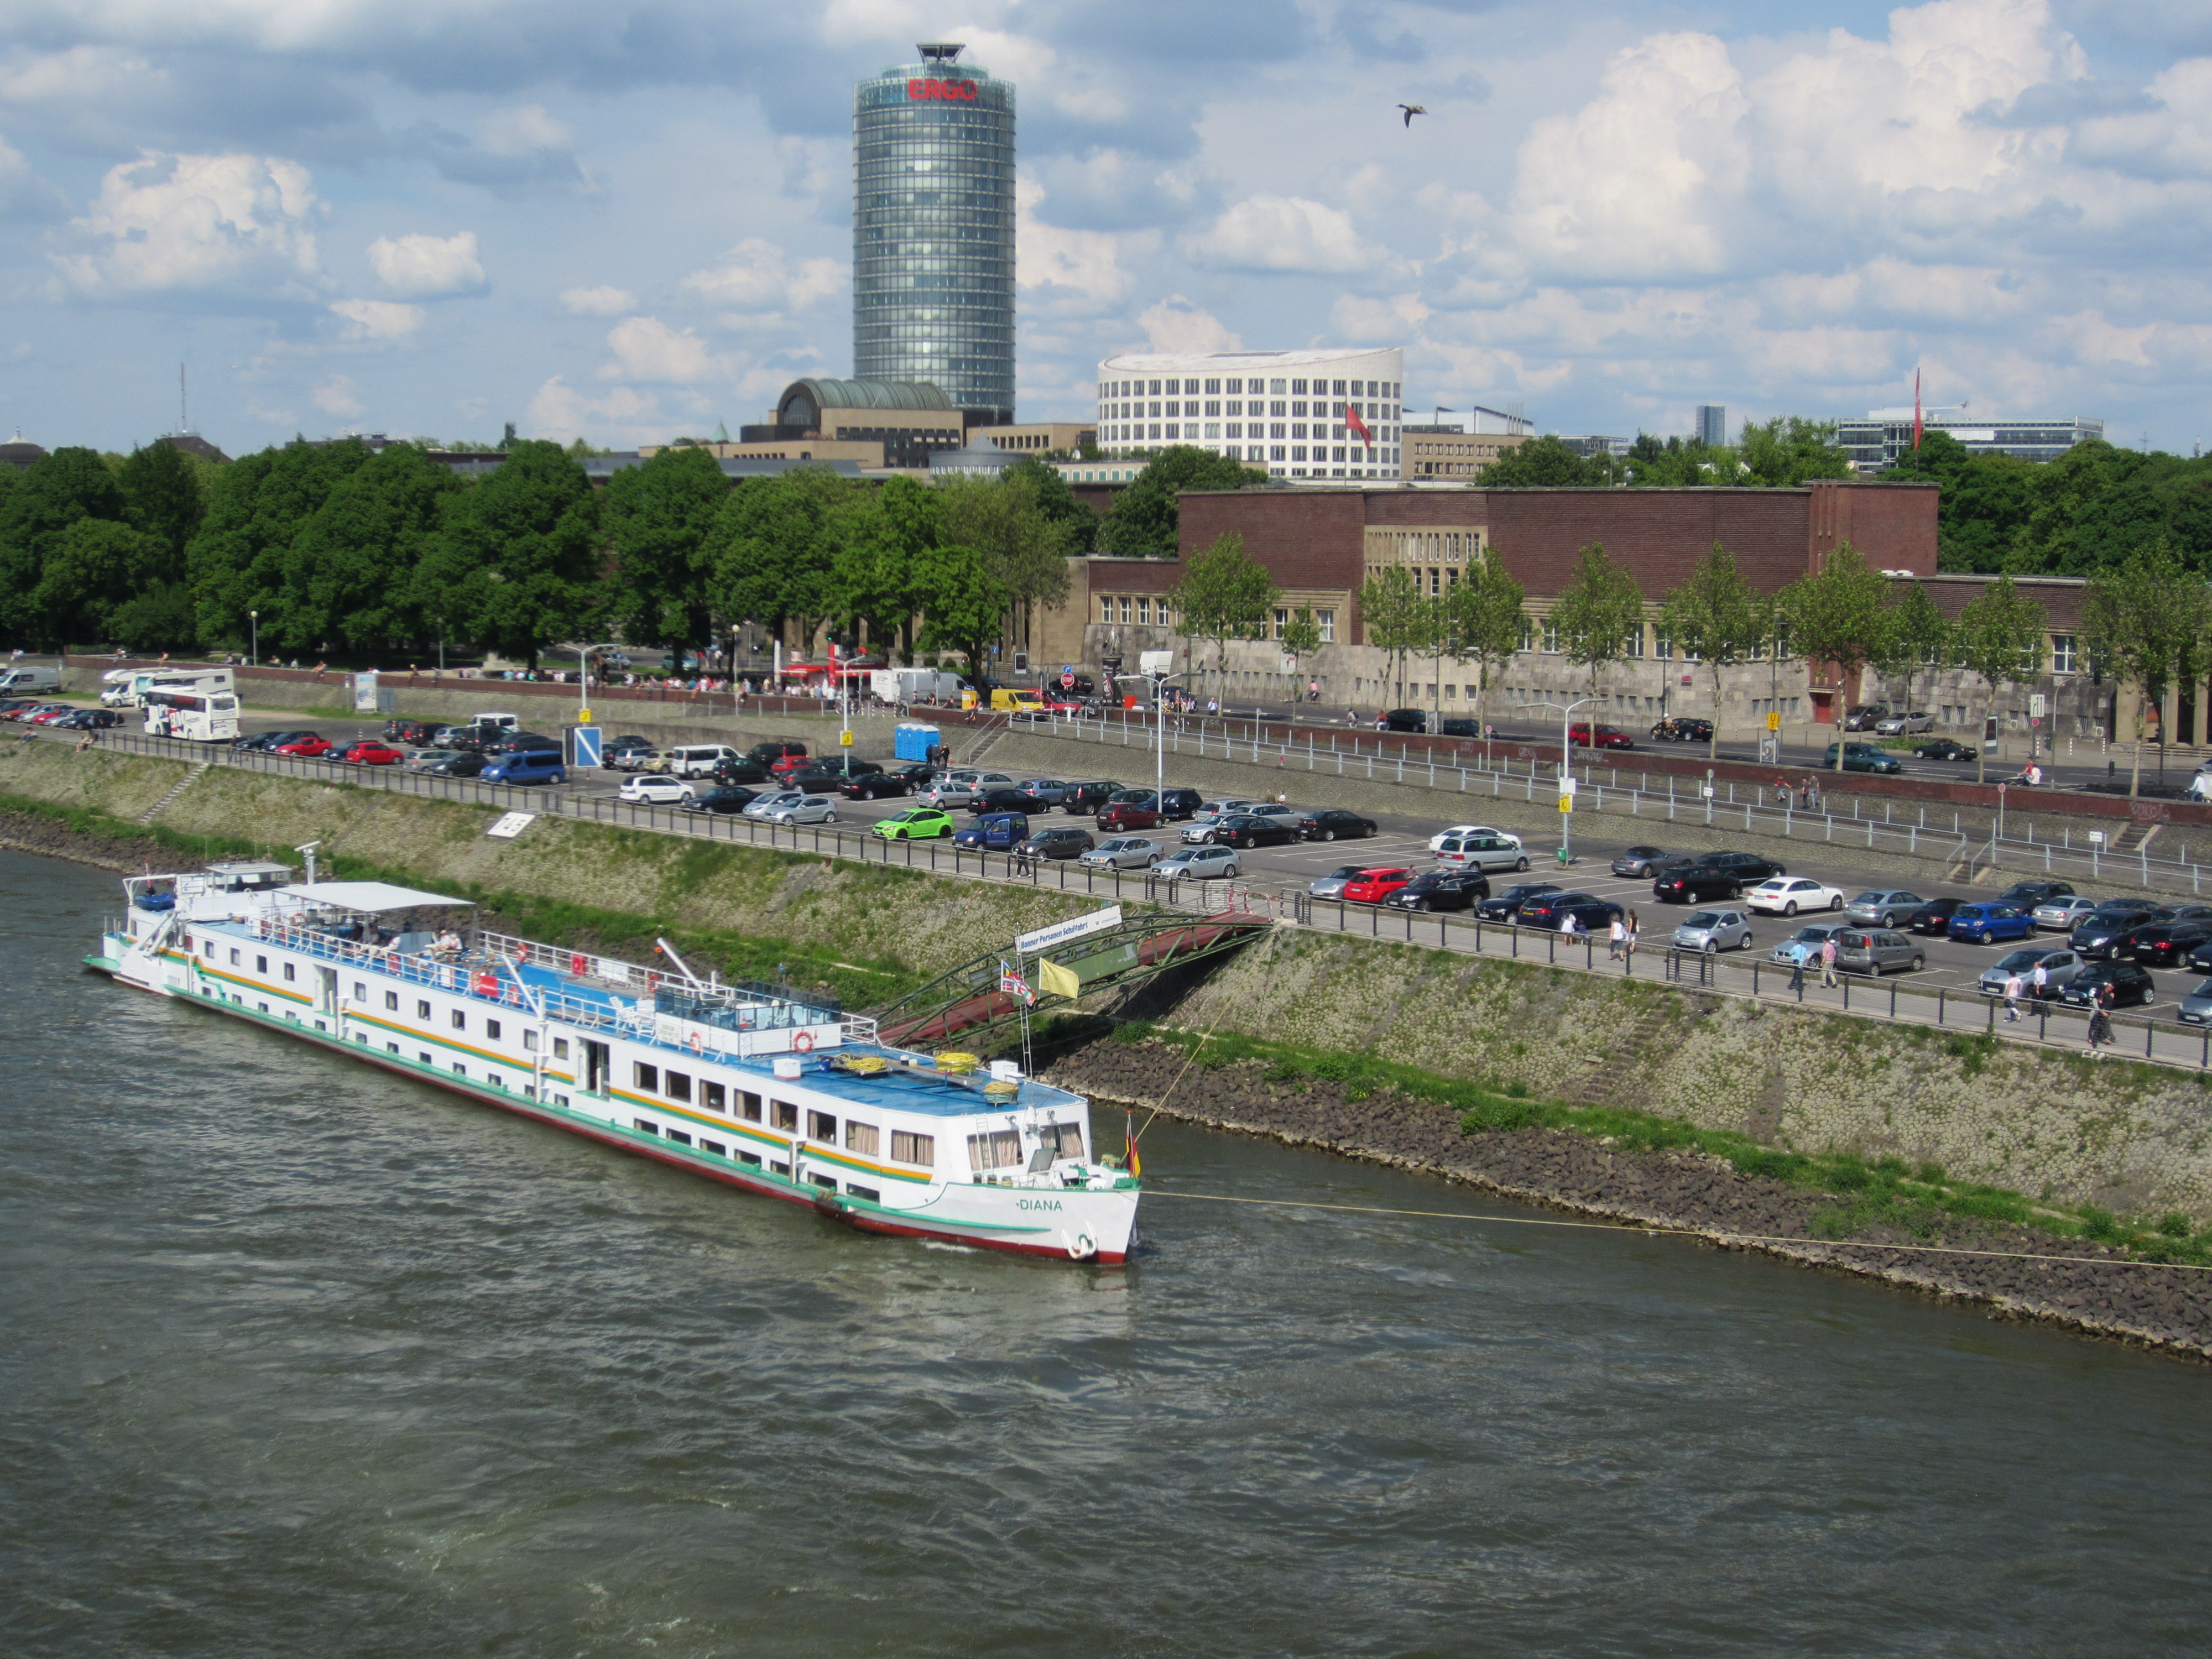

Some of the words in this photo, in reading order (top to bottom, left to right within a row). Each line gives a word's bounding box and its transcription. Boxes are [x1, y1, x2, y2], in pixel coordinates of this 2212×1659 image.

[907, 79, 978, 100] ERGO
[1021, 938, 1039, 949] Bonner
[1039, 931, 1062, 943] Personen
[1062, 921, 1088, 936] Schiffahrt
[1020, 1199, 1063, 1212] DIANA
